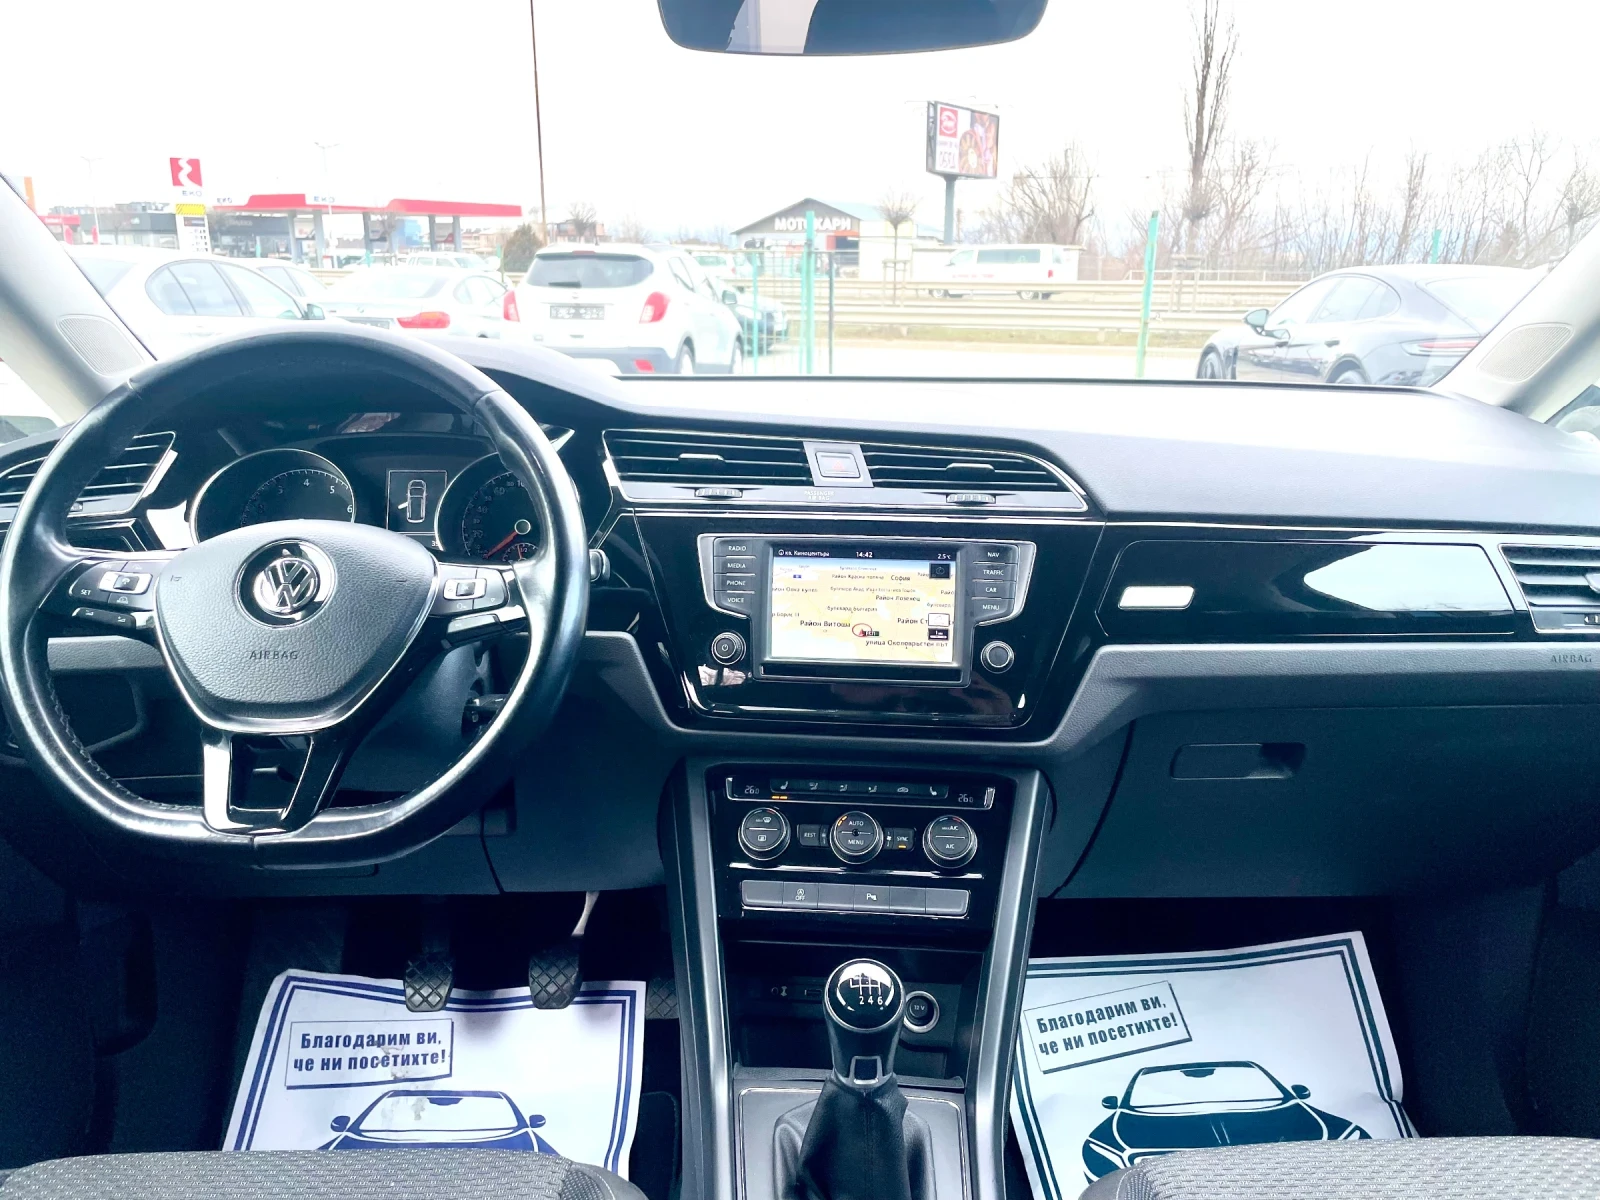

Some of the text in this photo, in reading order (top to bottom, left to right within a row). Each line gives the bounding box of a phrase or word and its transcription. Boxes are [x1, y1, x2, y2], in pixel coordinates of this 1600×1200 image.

[775, 216, 851, 231] МОТКАРИ
[303, 478, 309, 487] 4
[329, 485, 335, 494] 5
[347, 505, 353, 513] 6
[890, 574, 911, 582] София
[249, 650, 298, 661] AIRBAG
[1551, 654, 1593, 663] AIRBAG
[859, 996, 883, 1005] 2 4 6
[1036, 995, 1167, 1034] Благодарим ви,
[1038, 1012, 1178, 1056] че ни посетихте!
[300, 1030, 442, 1050] Благодарим ви,
[293, 1048, 446, 1072] че ни посетихте!
